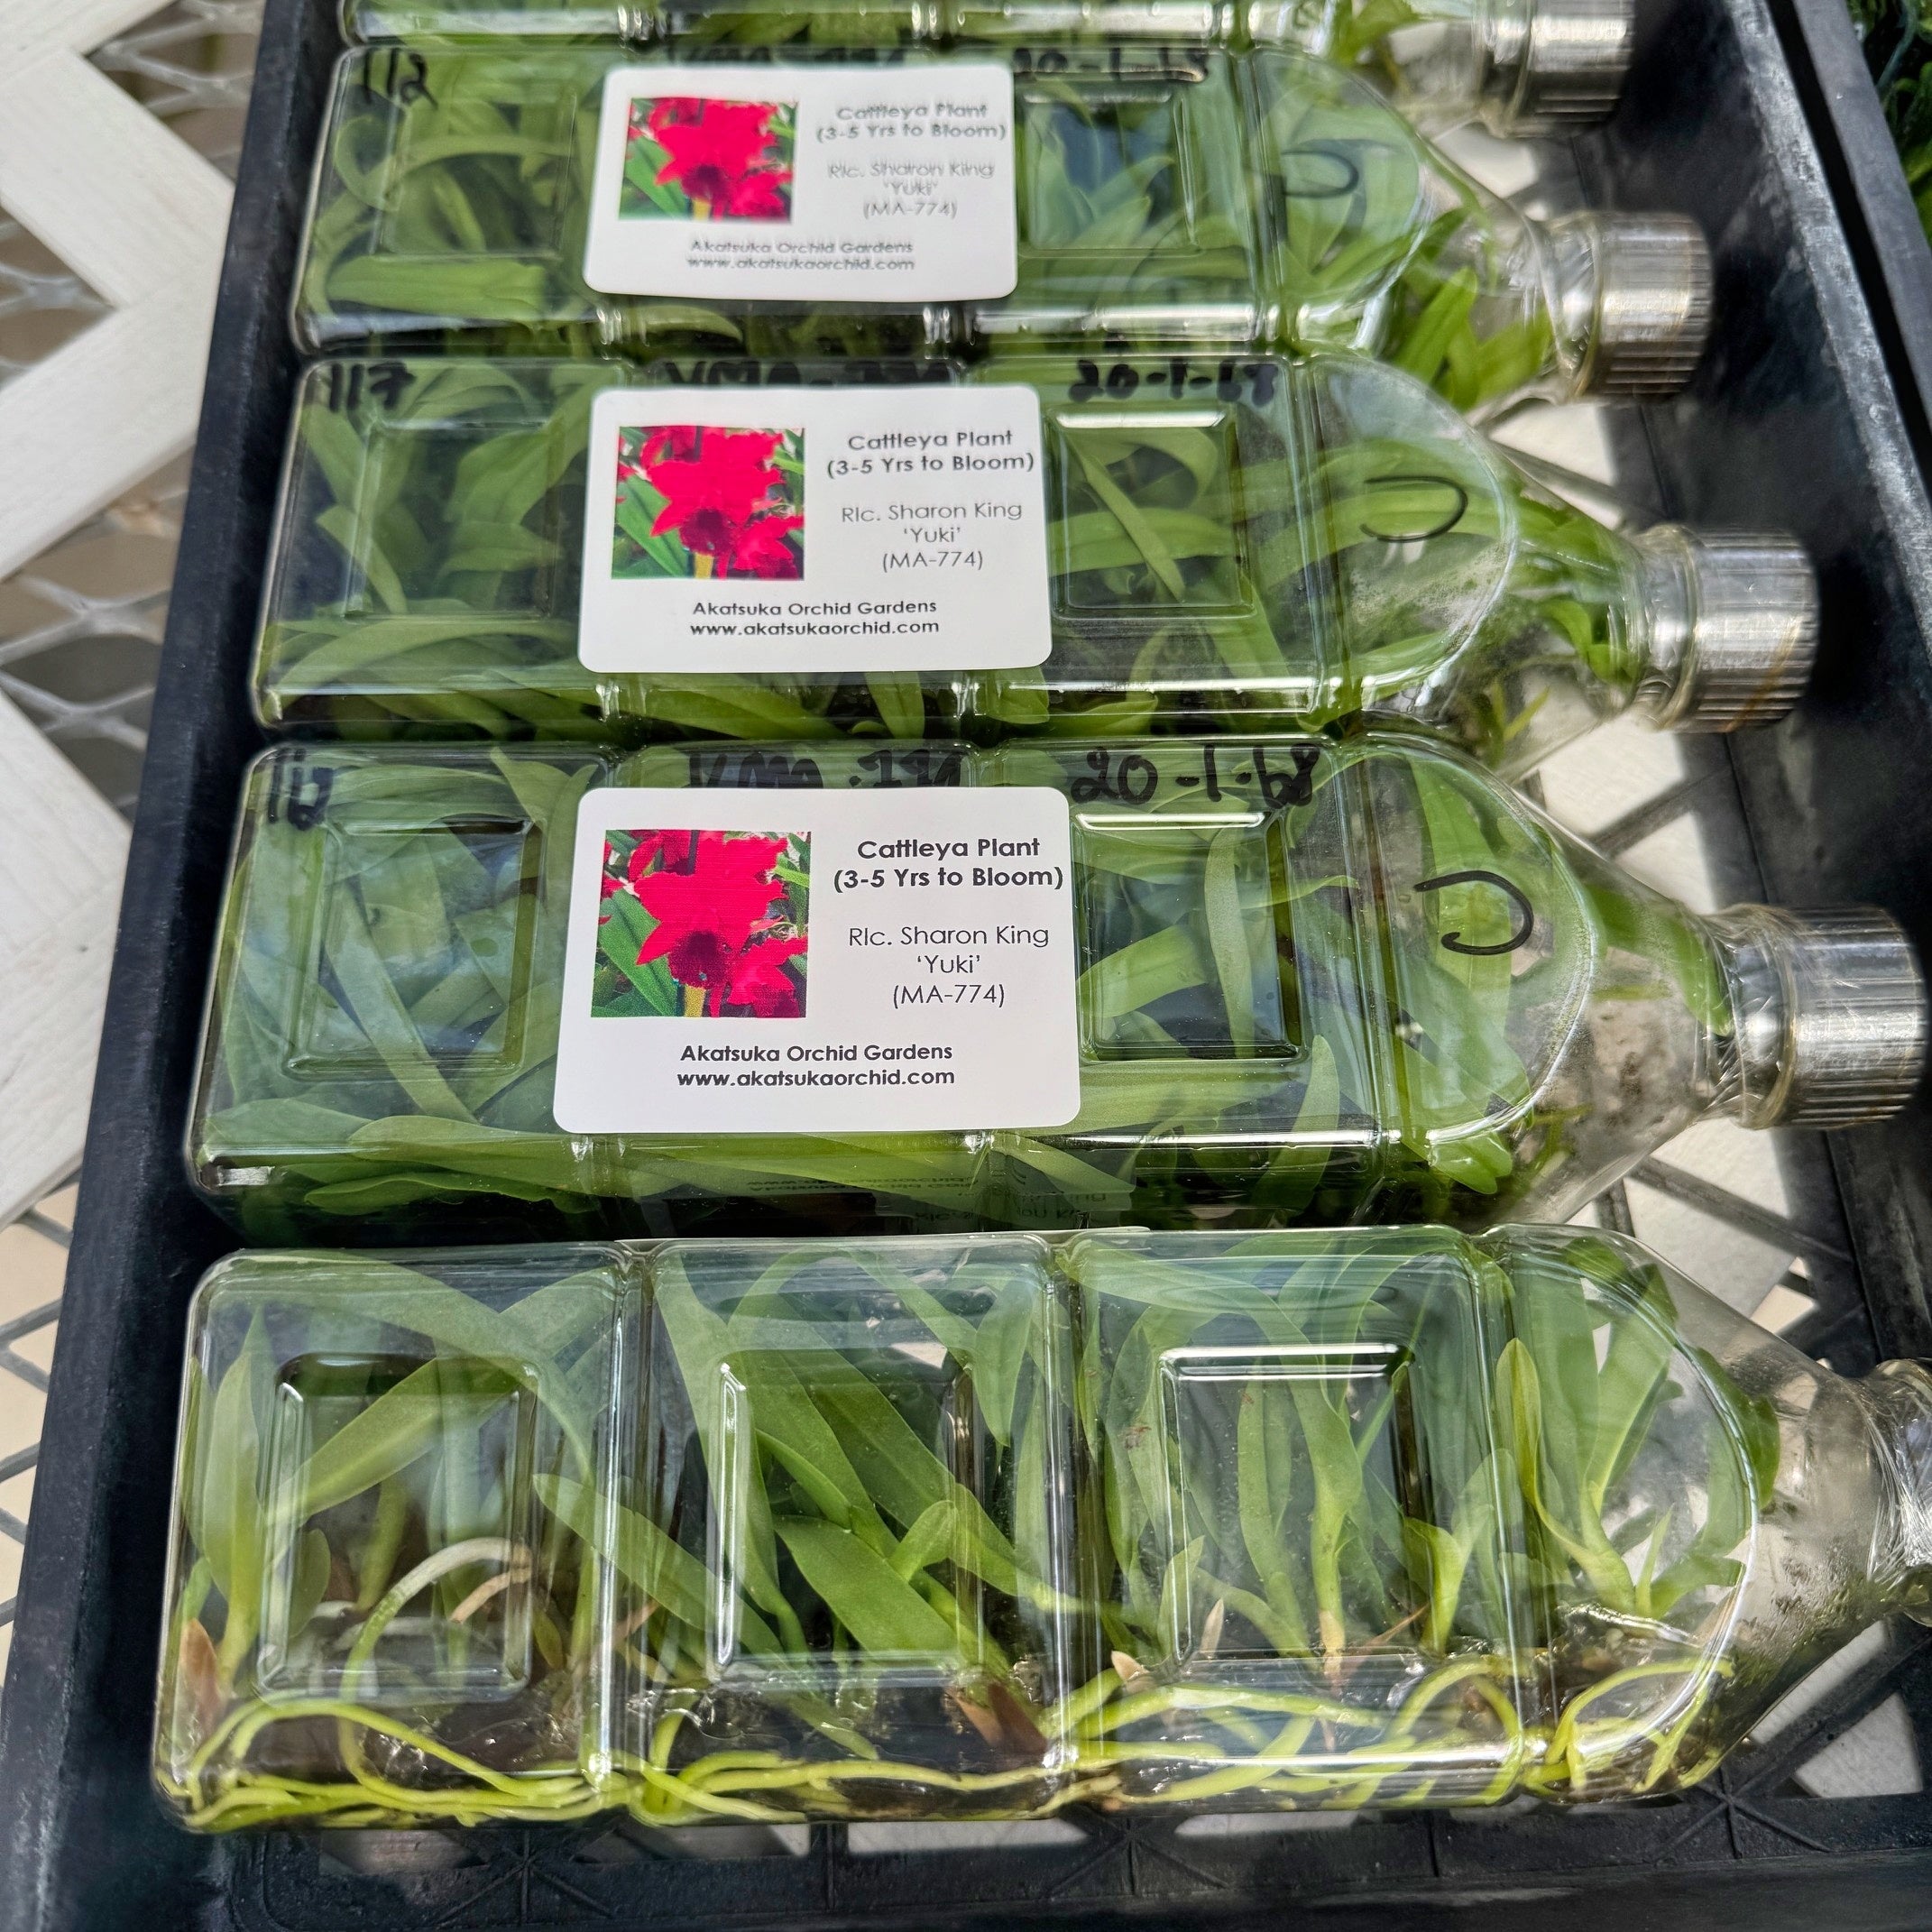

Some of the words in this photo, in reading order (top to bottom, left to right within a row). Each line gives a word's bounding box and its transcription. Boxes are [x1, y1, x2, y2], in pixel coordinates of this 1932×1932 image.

[836, 104, 928, 120] Cattleya
[935, 103, 987, 117] Plant
[816, 125, 859, 143] (3-5
[867, 125, 896, 136] Yrs
[903, 124, 923, 136] to
[931, 124, 1006, 141] Bloom)
[828, 162, 865, 179] Rlc.
[870, 161, 943, 177] Sharon
[949, 161, 995, 179] King
[863, 200, 957, 219] (MA-774)
[691, 240, 772, 253] Akatsuka
[777, 240, 835, 253] Orchid
[841, 240, 914, 253] Gardens
[686, 257, 915, 271] www.akatsukaorchid.com
[848, 433, 948, 451] Cattleya
[957, 430, 1013, 446] Plant
[827, 459, 872, 479] (3-5
[881, 457, 913, 474] Yrs
[921, 455, 943, 471] to
[952, 453, 1034, 472] Bloom)
[842, 507, 880, 522] Rlc.
[888, 504, 966, 520] Sharon
[975, 501, 1022, 520] King
[882, 551, 983, 573] (MA-774)
[693, 602, 781, 616] Akatsuka
[788, 602, 851, 615] Orchid
[858, 601, 937, 614] Gardens
[691, 621, 939, 636] www.akatsukaorchid.com
[858, 839, 968, 860] Cattleya
[978, 838, 1040, 856] Plant
[834, 869, 885, 893] (3-5
[894, 869, 930, 887] Yrs
[938, 868, 962, 886] to
[972, 867, 1063, 889] Bloom)
[849, 927, 892, 945] Rlc.
[900, 926, 987, 944] Sharon
[997, 925, 1048, 947] King
[894, 984, 1005, 1008] (MA-774)
[680, 1044, 780, 1062] Akatsuka
[787, 1044, 857, 1062] Orchid
[864, 1044, 952, 1061] Gardens
[677, 1069, 954, 1086] www.akatsukaorchid.com
